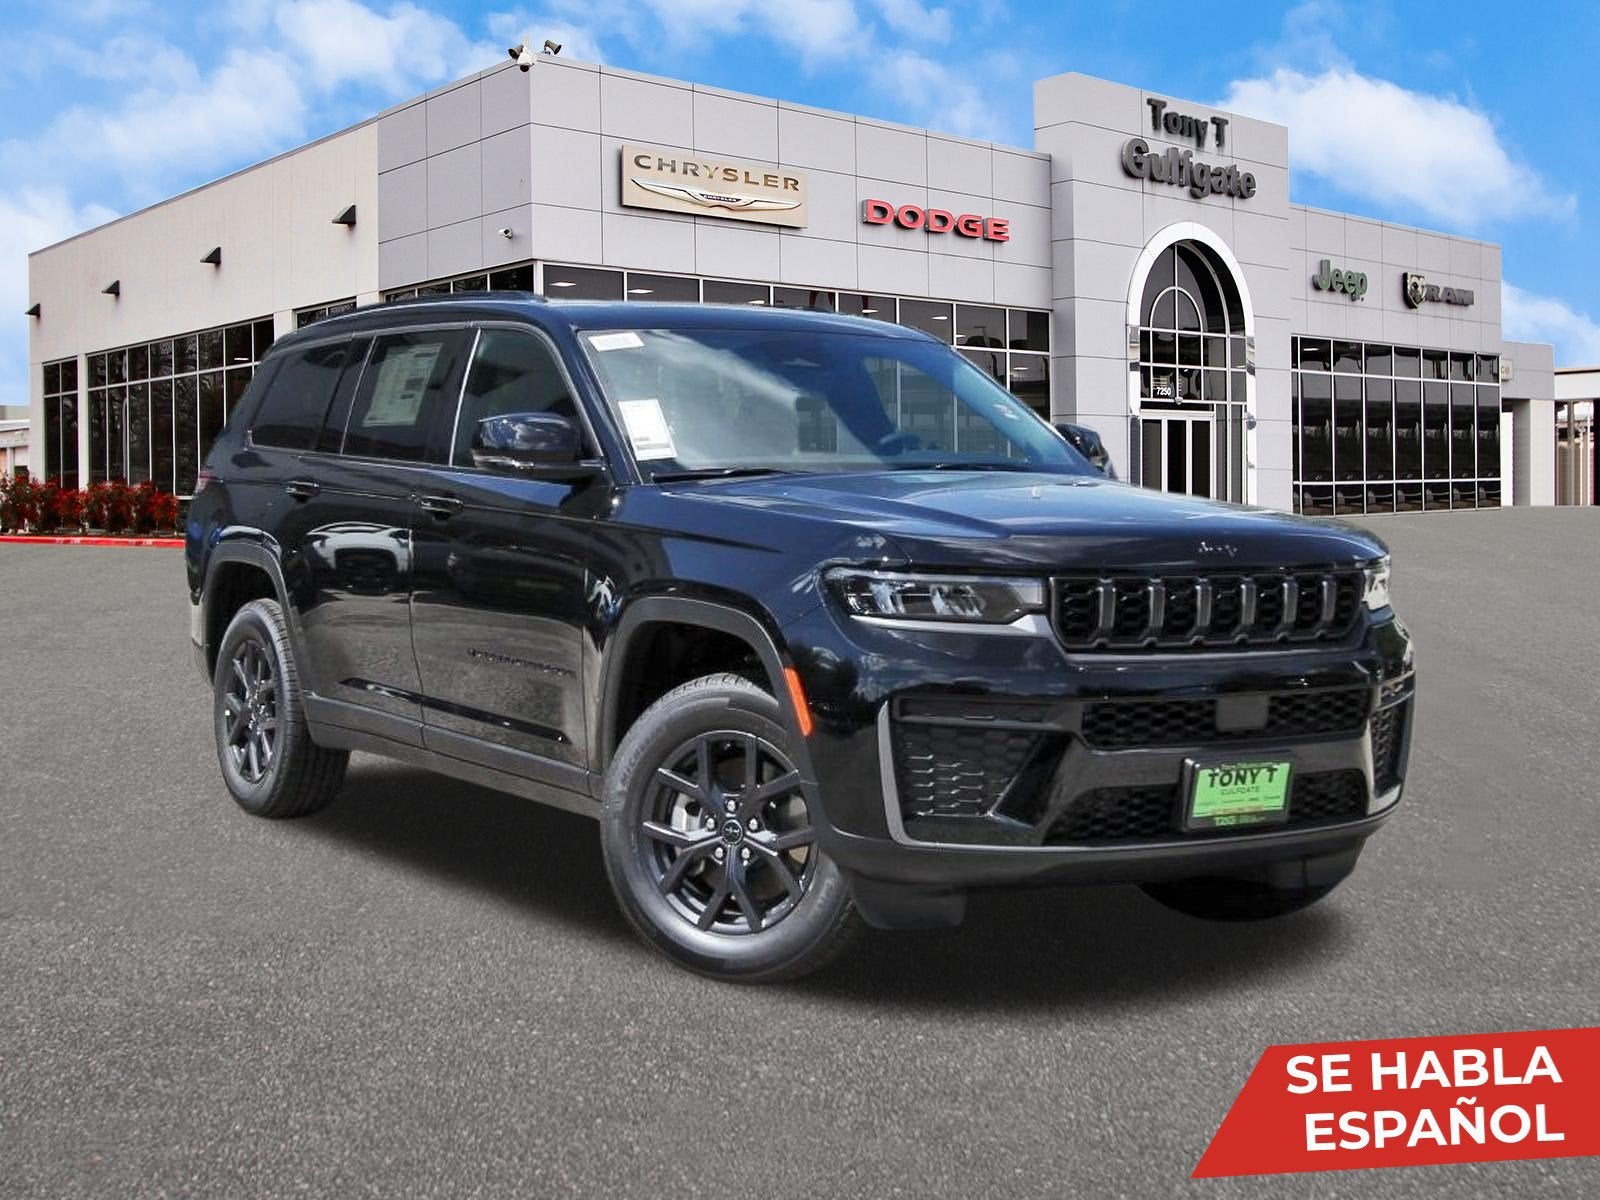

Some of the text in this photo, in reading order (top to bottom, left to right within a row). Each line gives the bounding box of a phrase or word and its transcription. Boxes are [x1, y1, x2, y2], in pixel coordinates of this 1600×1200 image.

[1146, 98, 1229, 148] Tony T
[633, 154, 800, 192] CHRYSLER
[1121, 138, 1256, 199] Gulfgate
[862, 199, 1010, 242] DODGE
[1312, 259, 1368, 302] Jeep
[1424, 283, 1475, 306] RAM
[1207, 766, 1279, 788] TONY T
